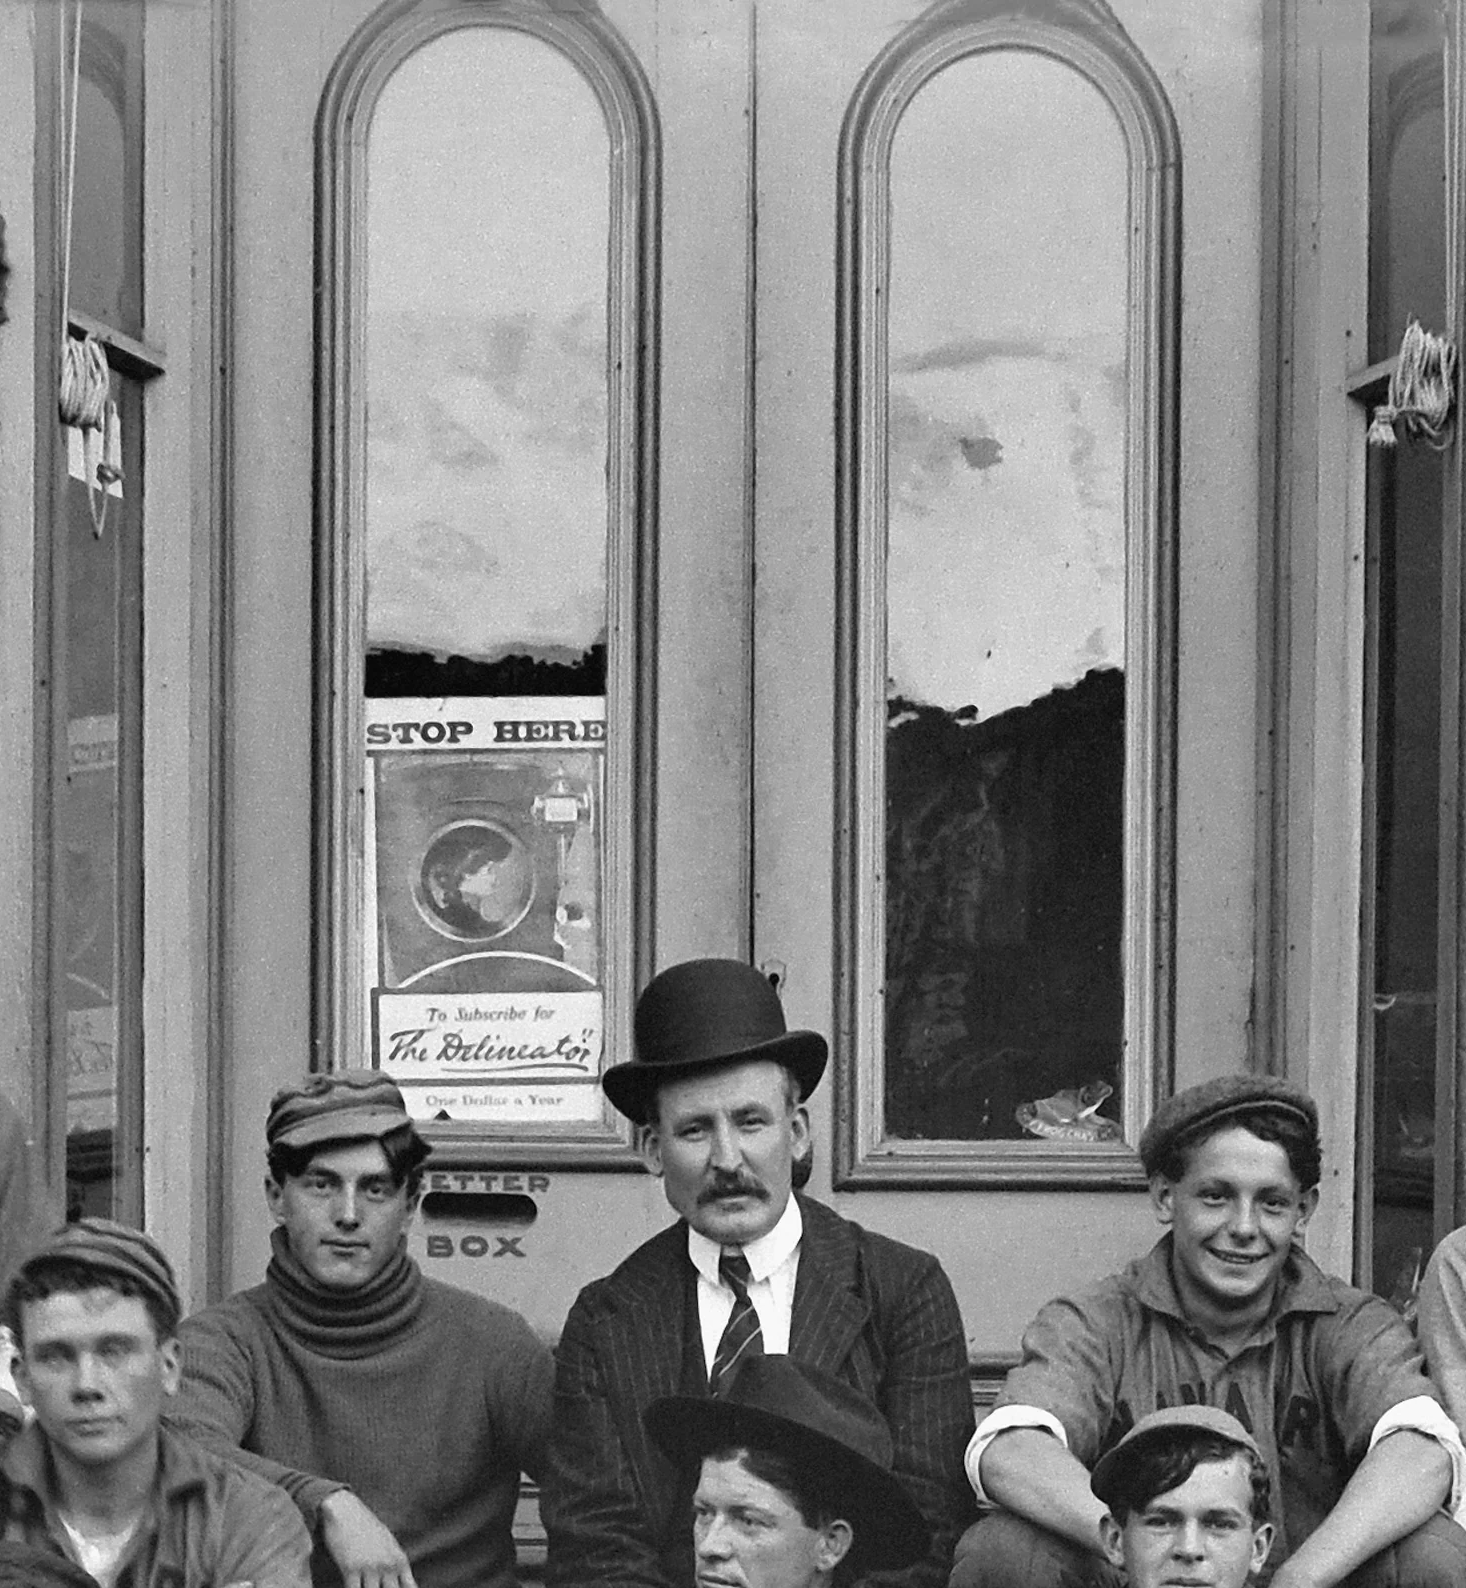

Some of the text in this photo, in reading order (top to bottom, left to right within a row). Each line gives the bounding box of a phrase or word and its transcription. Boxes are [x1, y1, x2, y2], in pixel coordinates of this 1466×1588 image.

[366, 719, 608, 744] STOP HERE
[427, 1005, 556, 1023] To Subscribe for
[388, 1028, 434, 1062] The
[462, 1094, 508, 1107] Dollar
[529, 1094, 564, 1107] Year
[419, 1174, 550, 1193] ETTER
[427, 1235, 527, 1258] BOX
